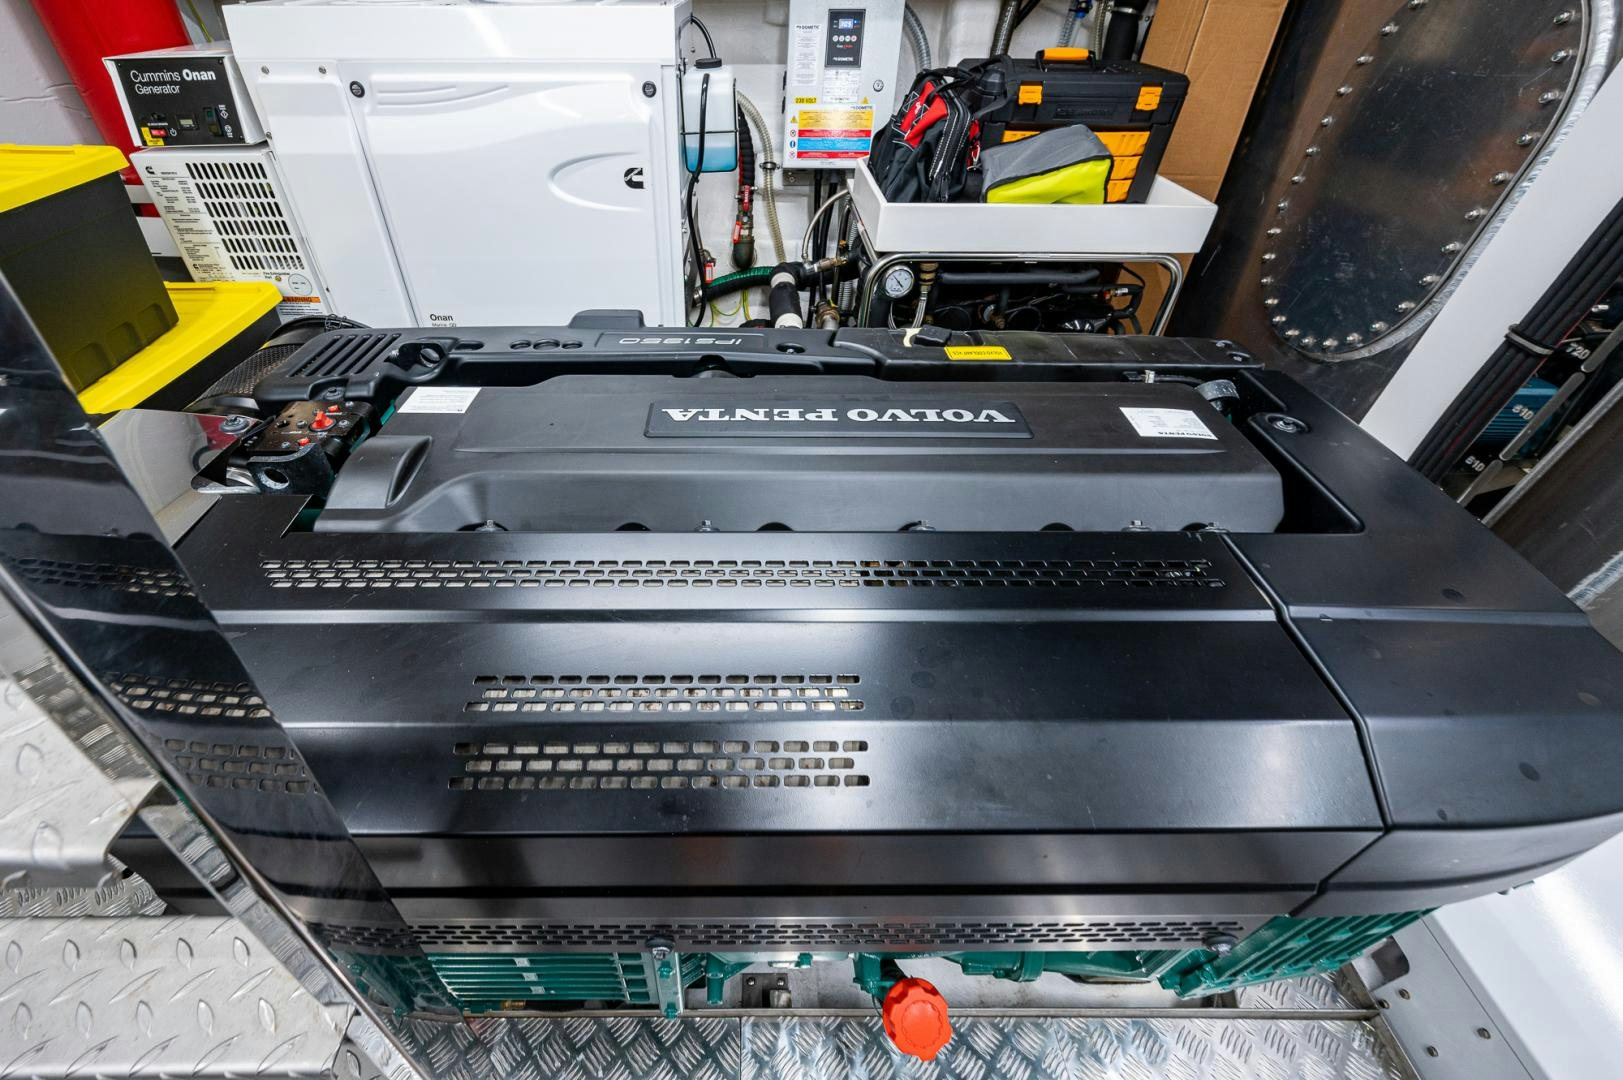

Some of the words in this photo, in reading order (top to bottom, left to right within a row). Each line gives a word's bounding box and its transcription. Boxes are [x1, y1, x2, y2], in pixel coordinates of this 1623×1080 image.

[130, 69, 180, 82] Cummins
[182, 68, 216, 81] Onan
[135, 84, 180, 94] Generator
[429, 313, 453, 322] Onan
[1565, 343, 1590, 360] 720
[661, 408, 839, 422] PENTA
[846, 408, 1016, 423] VOLVO
